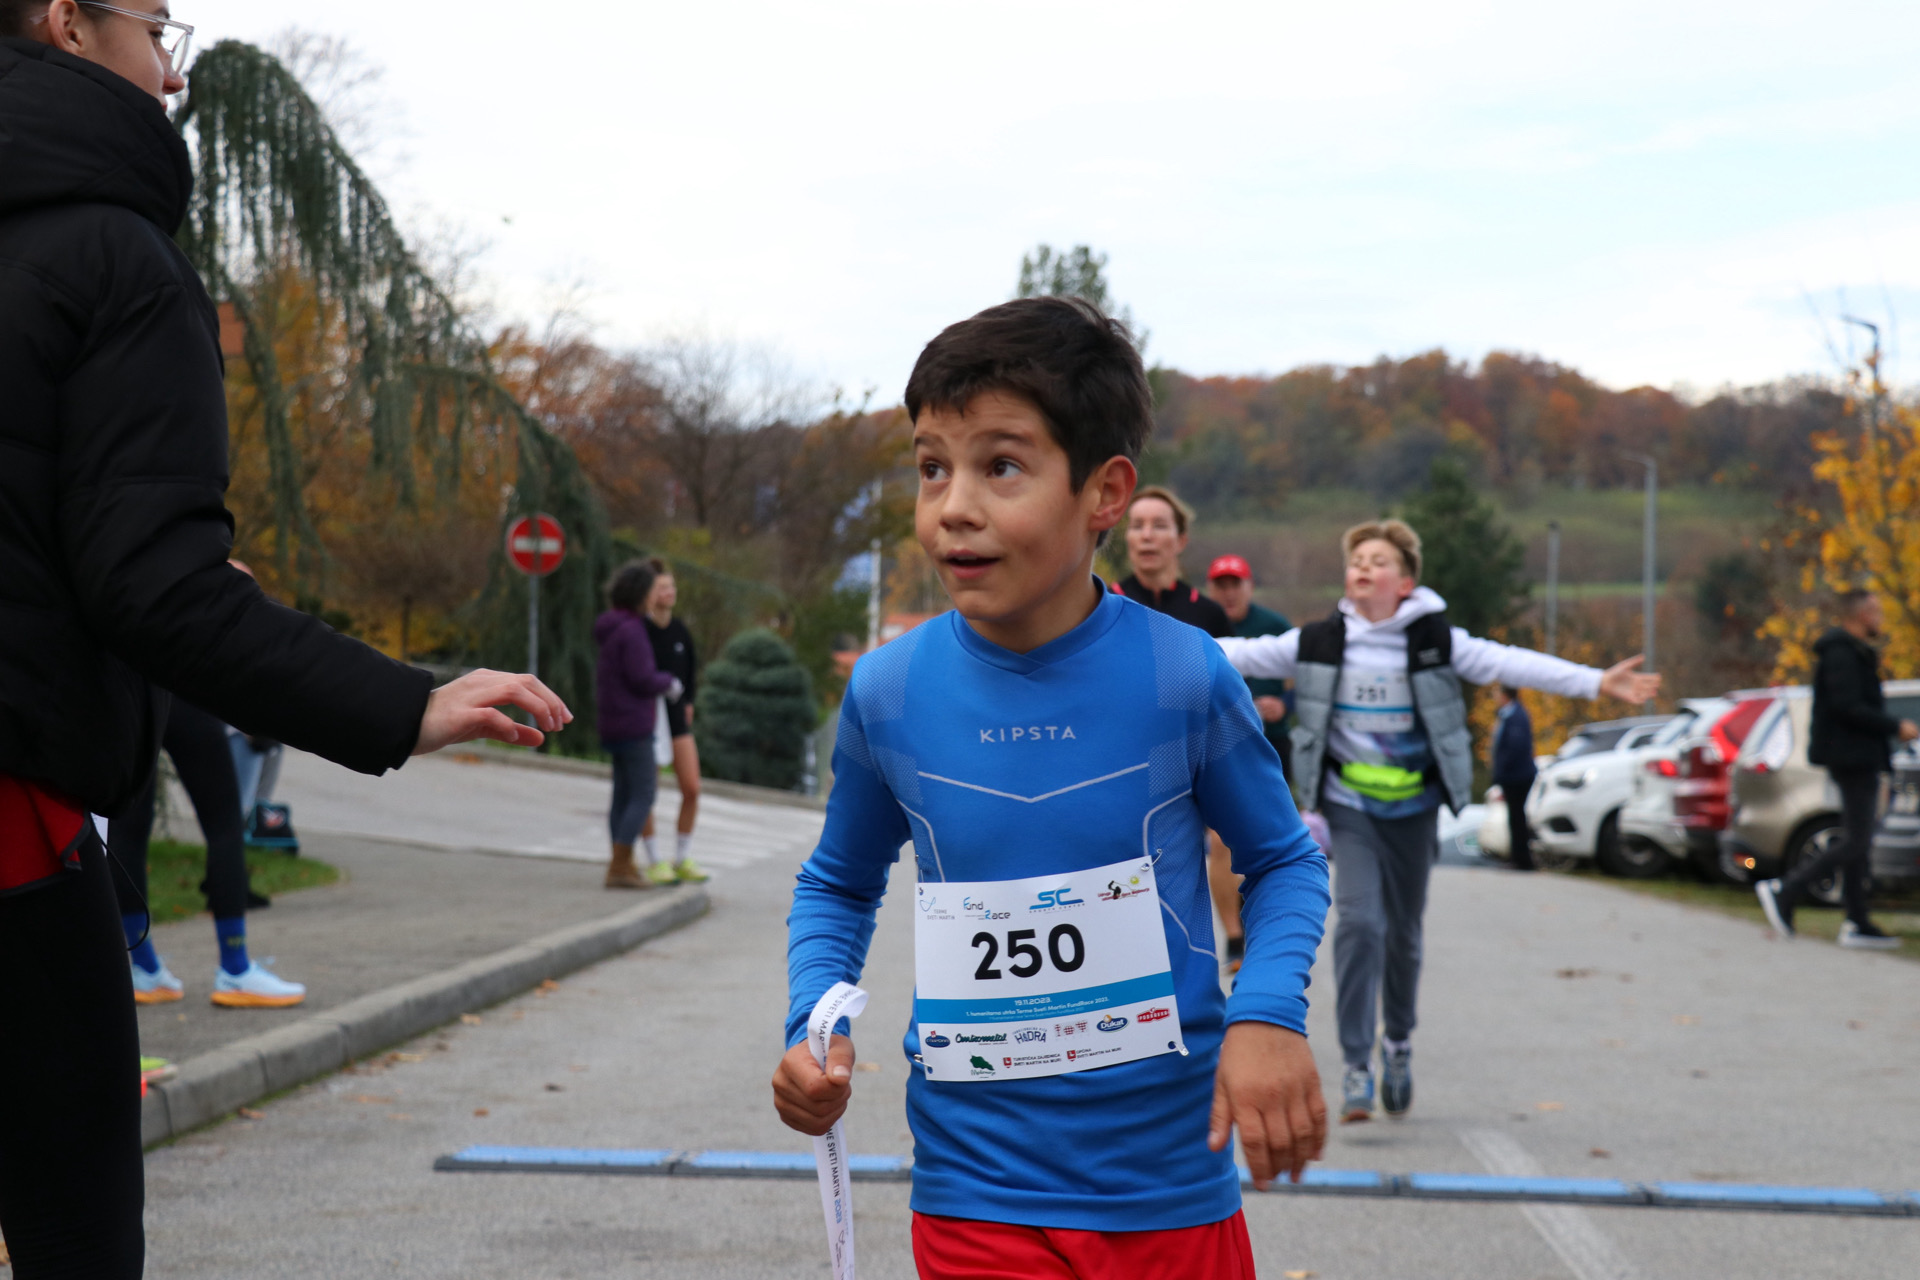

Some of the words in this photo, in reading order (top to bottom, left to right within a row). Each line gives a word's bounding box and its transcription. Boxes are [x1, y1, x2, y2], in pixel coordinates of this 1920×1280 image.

[980, 726, 1076, 743] KIPSTA
[963, 897, 984, 910] Fund
[971, 924, 1085, 980] 250
[824, 998, 842, 1018] SVETI
[1100, 1019, 1124, 1029] Dukat
[827, 1142, 838, 1165] SVETI
[831, 1167, 841, 1197] MARTIN
